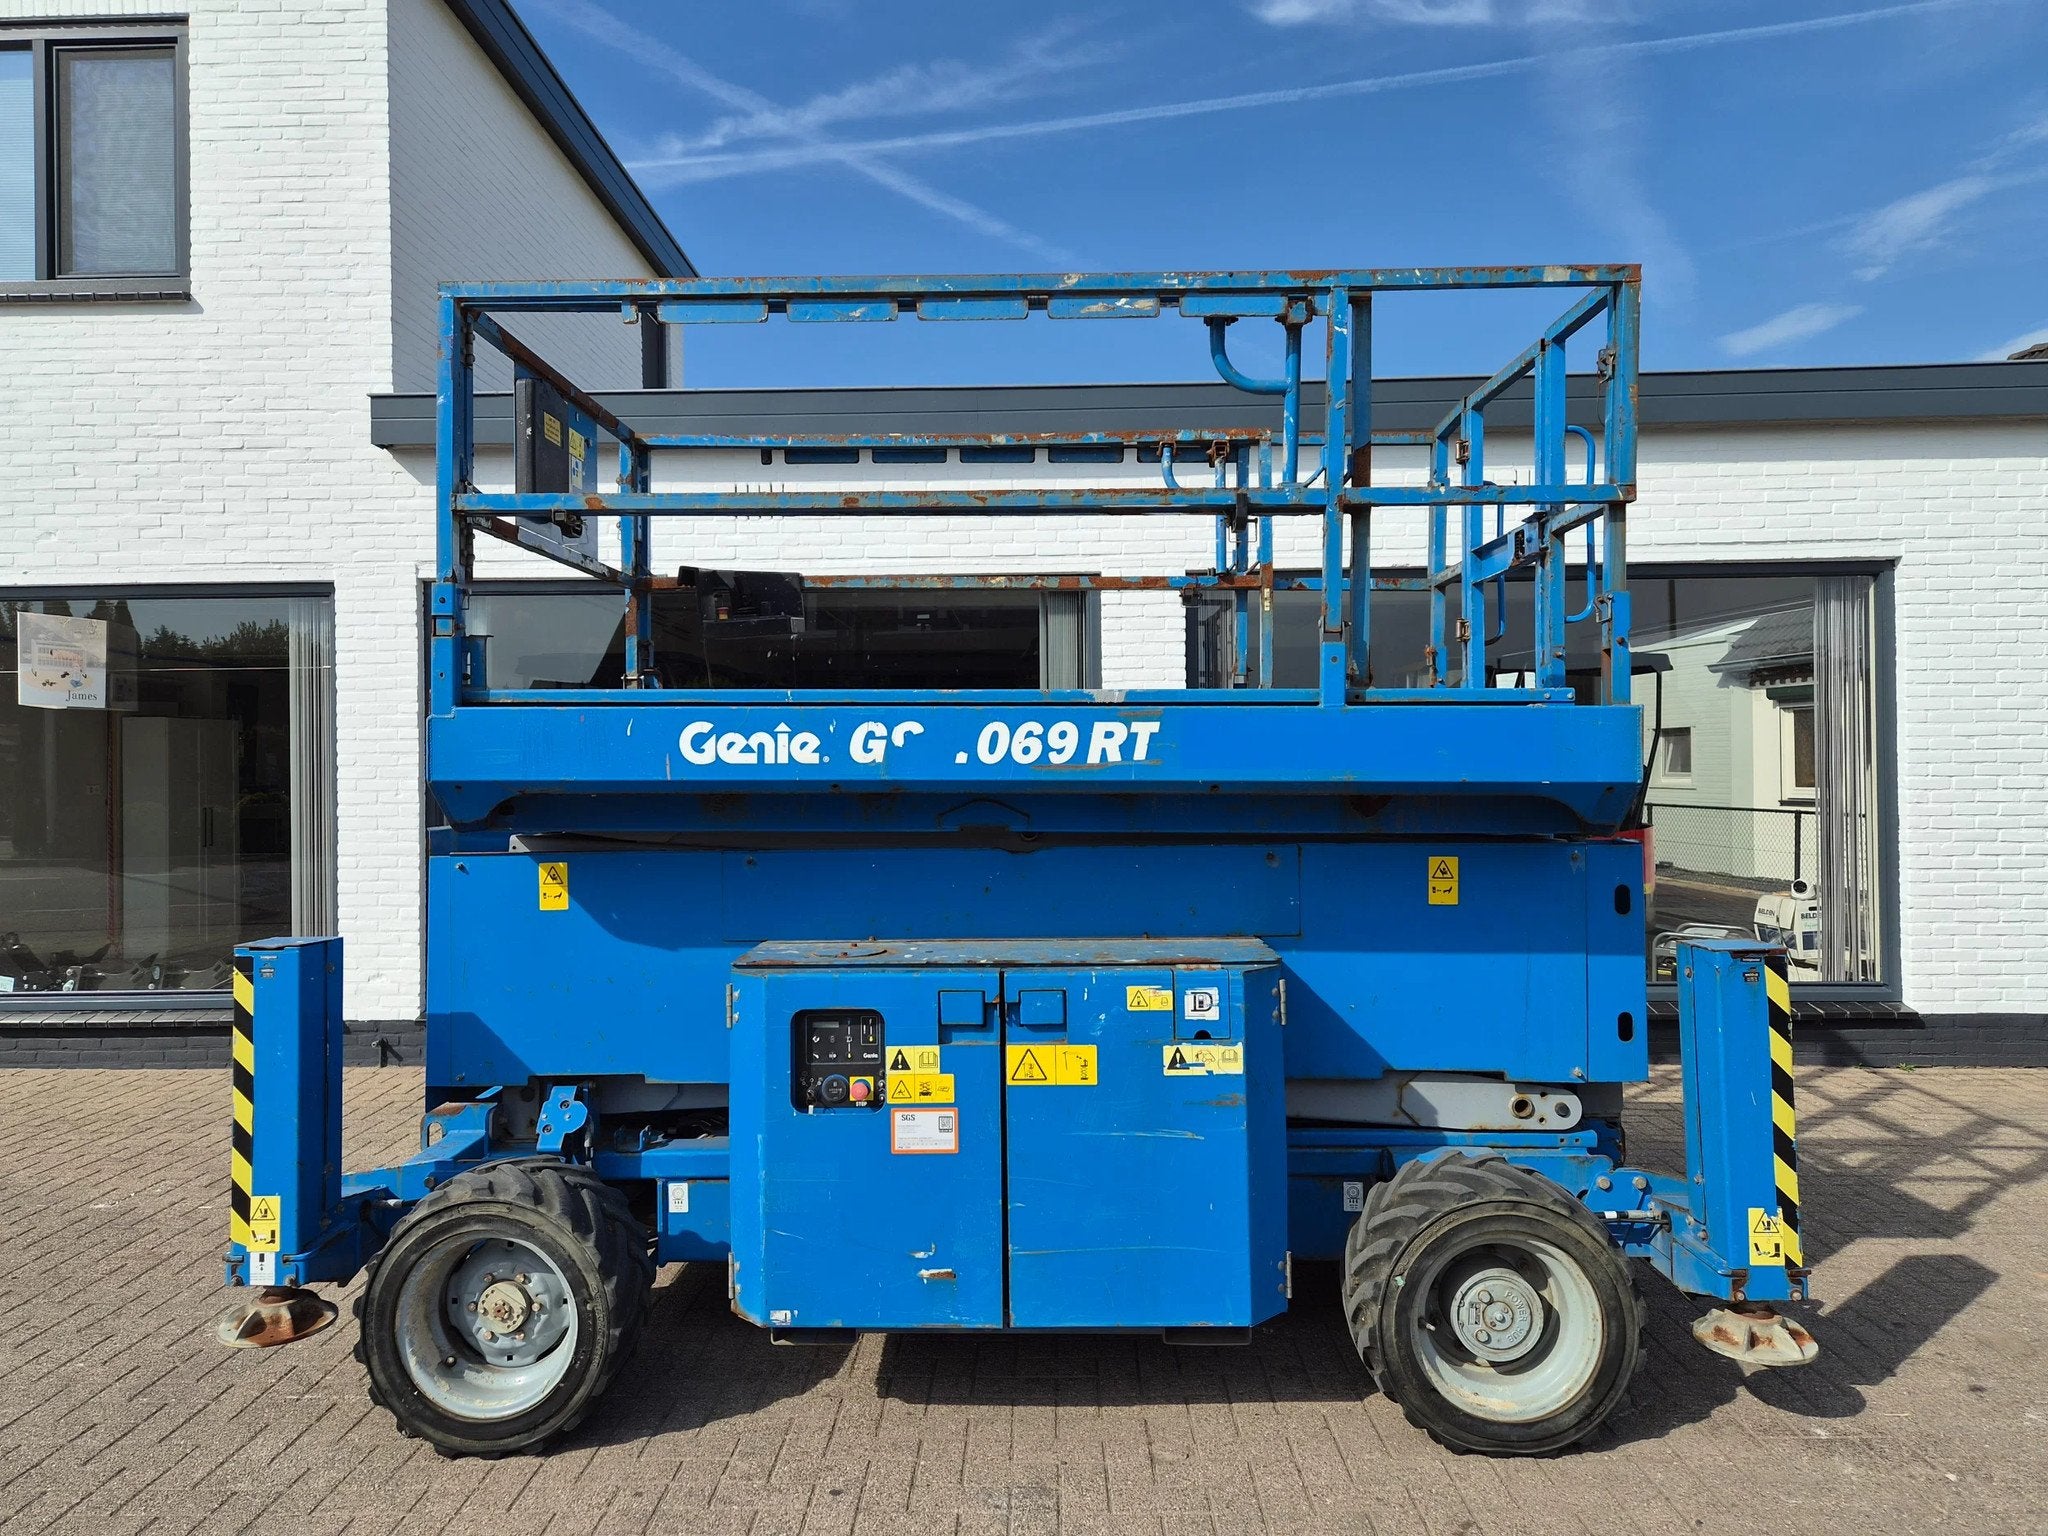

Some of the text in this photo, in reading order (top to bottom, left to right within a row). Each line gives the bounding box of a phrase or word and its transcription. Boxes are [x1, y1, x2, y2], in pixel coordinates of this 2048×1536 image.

[66, 690, 97, 701] James
[678, 720, 821, 765] Genie
[1086, 721, 1160, 764] RT
[1758, 908, 1775, 916] BELDEN
[1504, 1290, 1527, 1322] POWER
